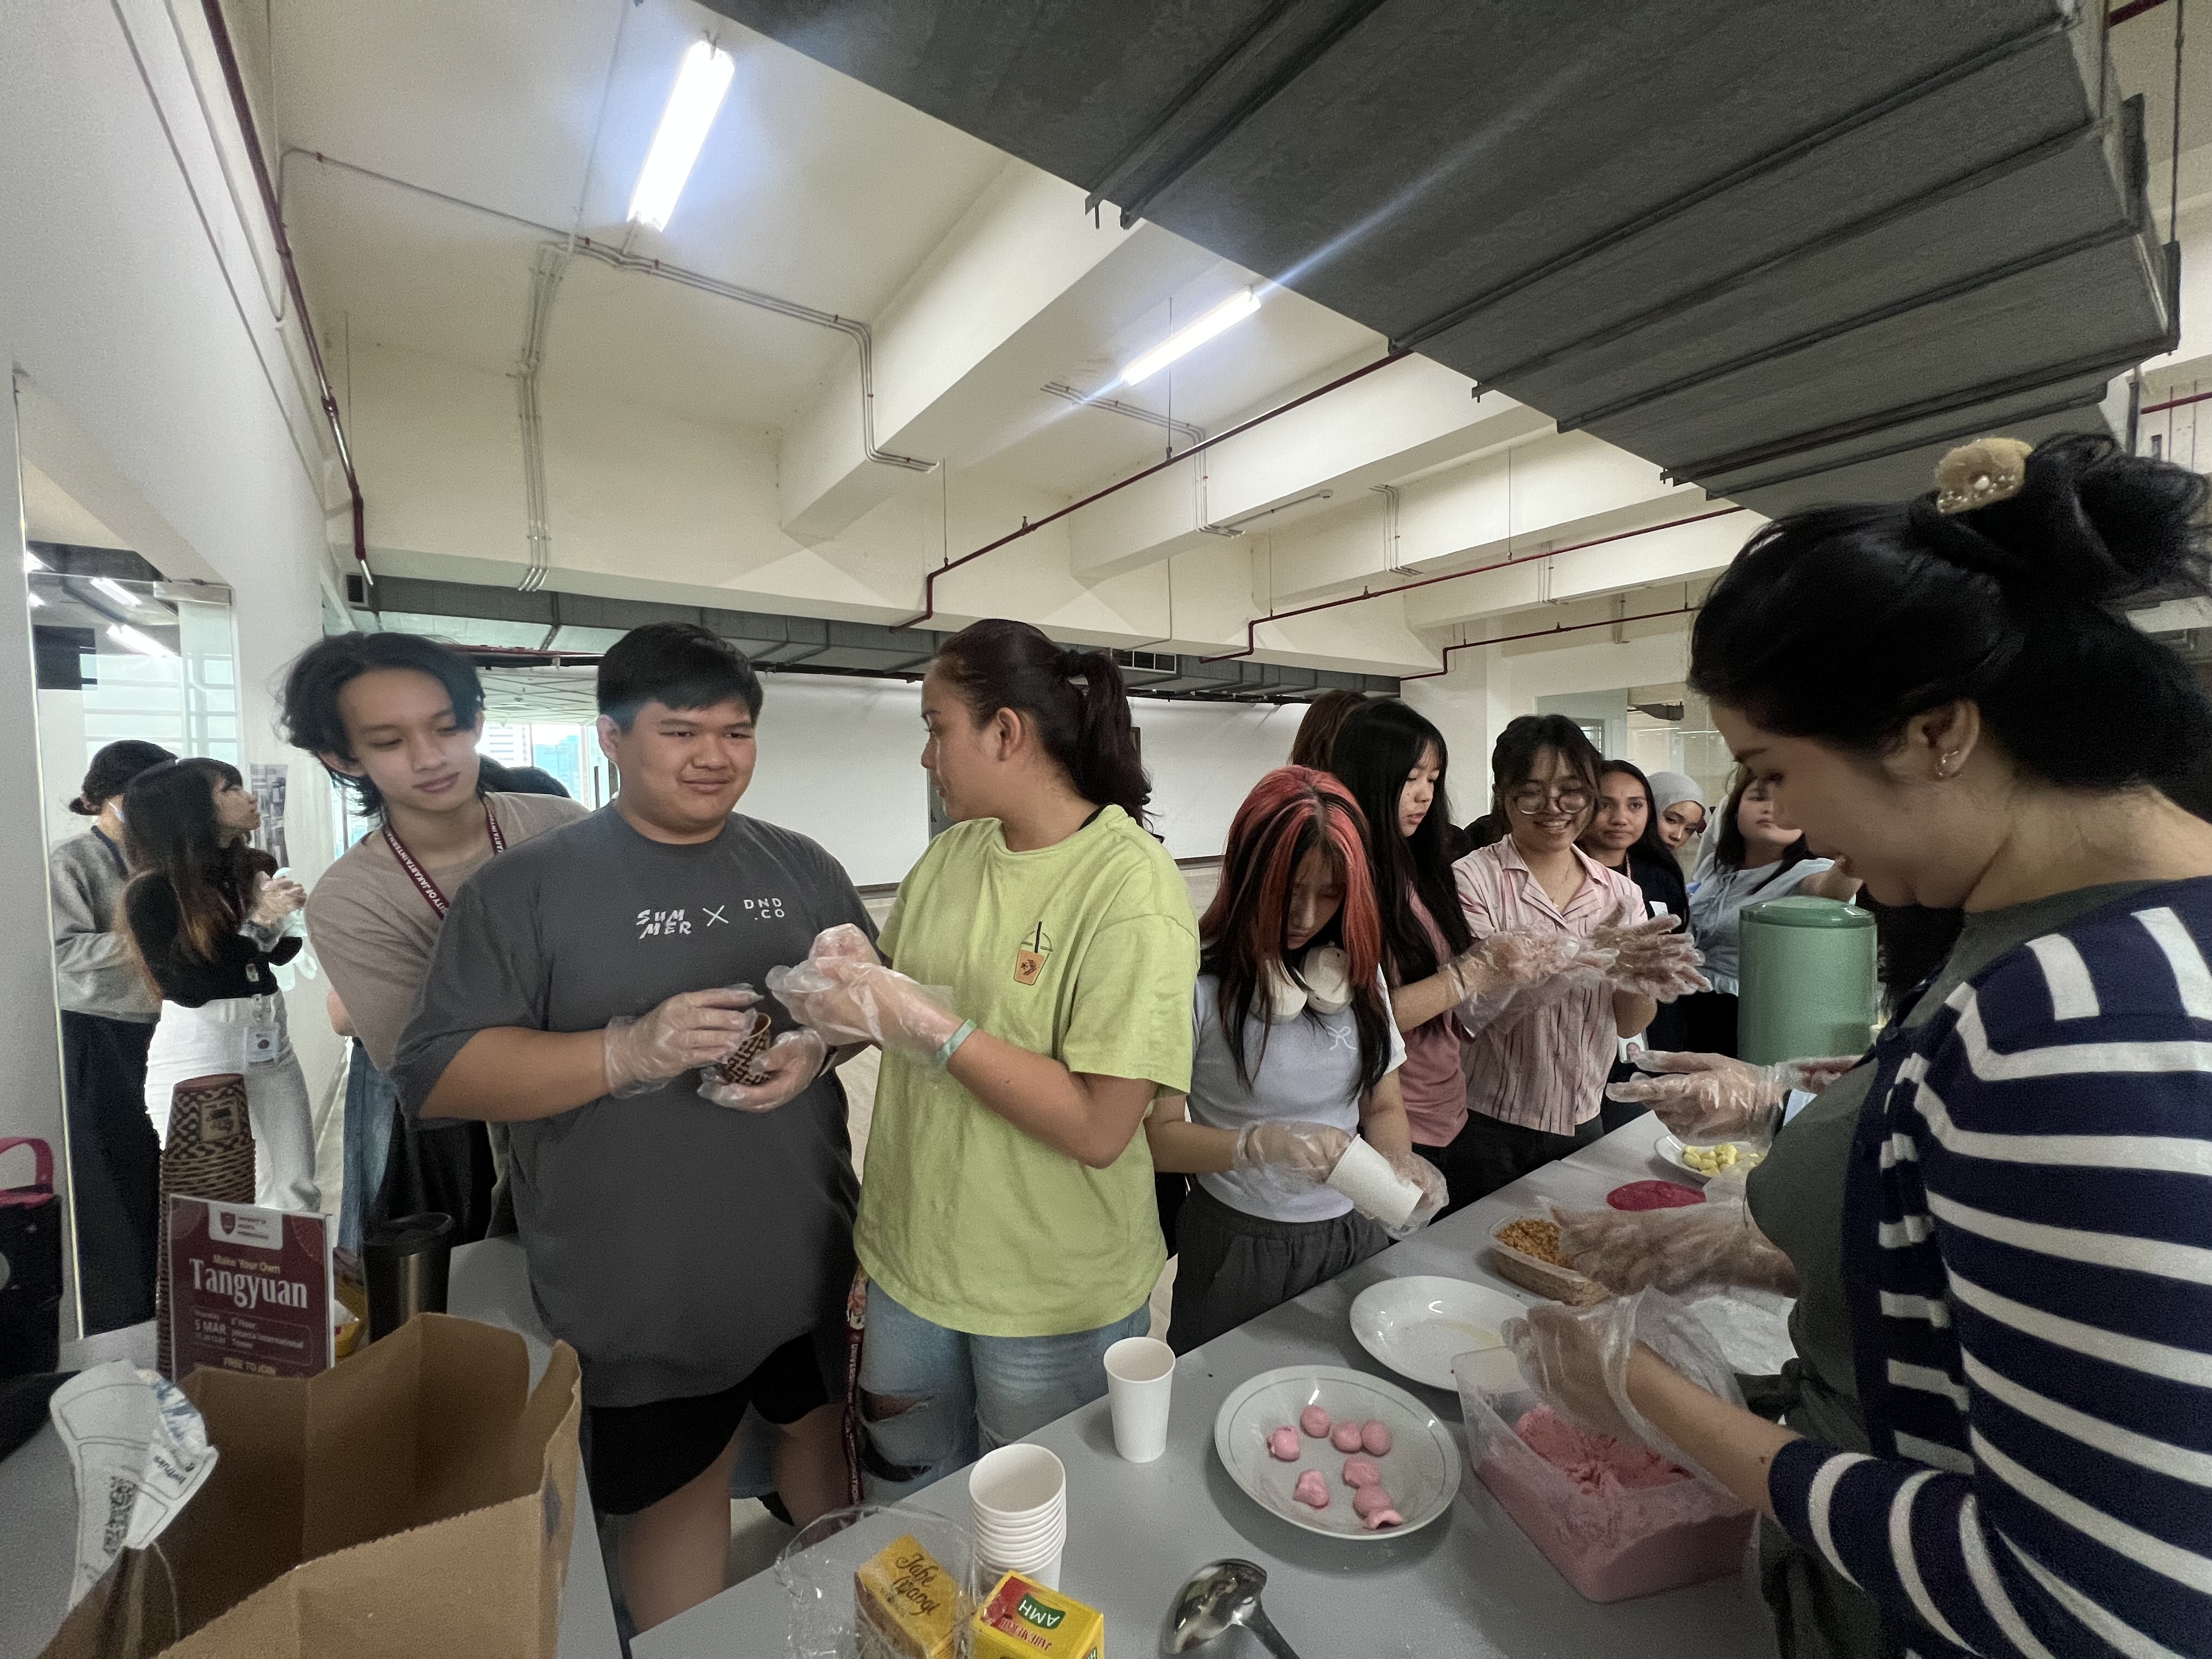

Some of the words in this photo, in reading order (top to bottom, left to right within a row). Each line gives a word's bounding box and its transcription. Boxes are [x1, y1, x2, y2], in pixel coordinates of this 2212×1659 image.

[406, 859, 431, 889] JAKARTA
[426, 889, 437, 899] OF
[744, 898, 782, 909] DND
[636, 909, 685, 926] SUM
[639, 921, 692, 939] MER
[259, 1262, 280, 1274] Own
[189, 1258, 308, 1309] Tangyuan
[895, 1554, 939, 1588] Jahe
[1019, 1600, 1060, 1627] AMH
